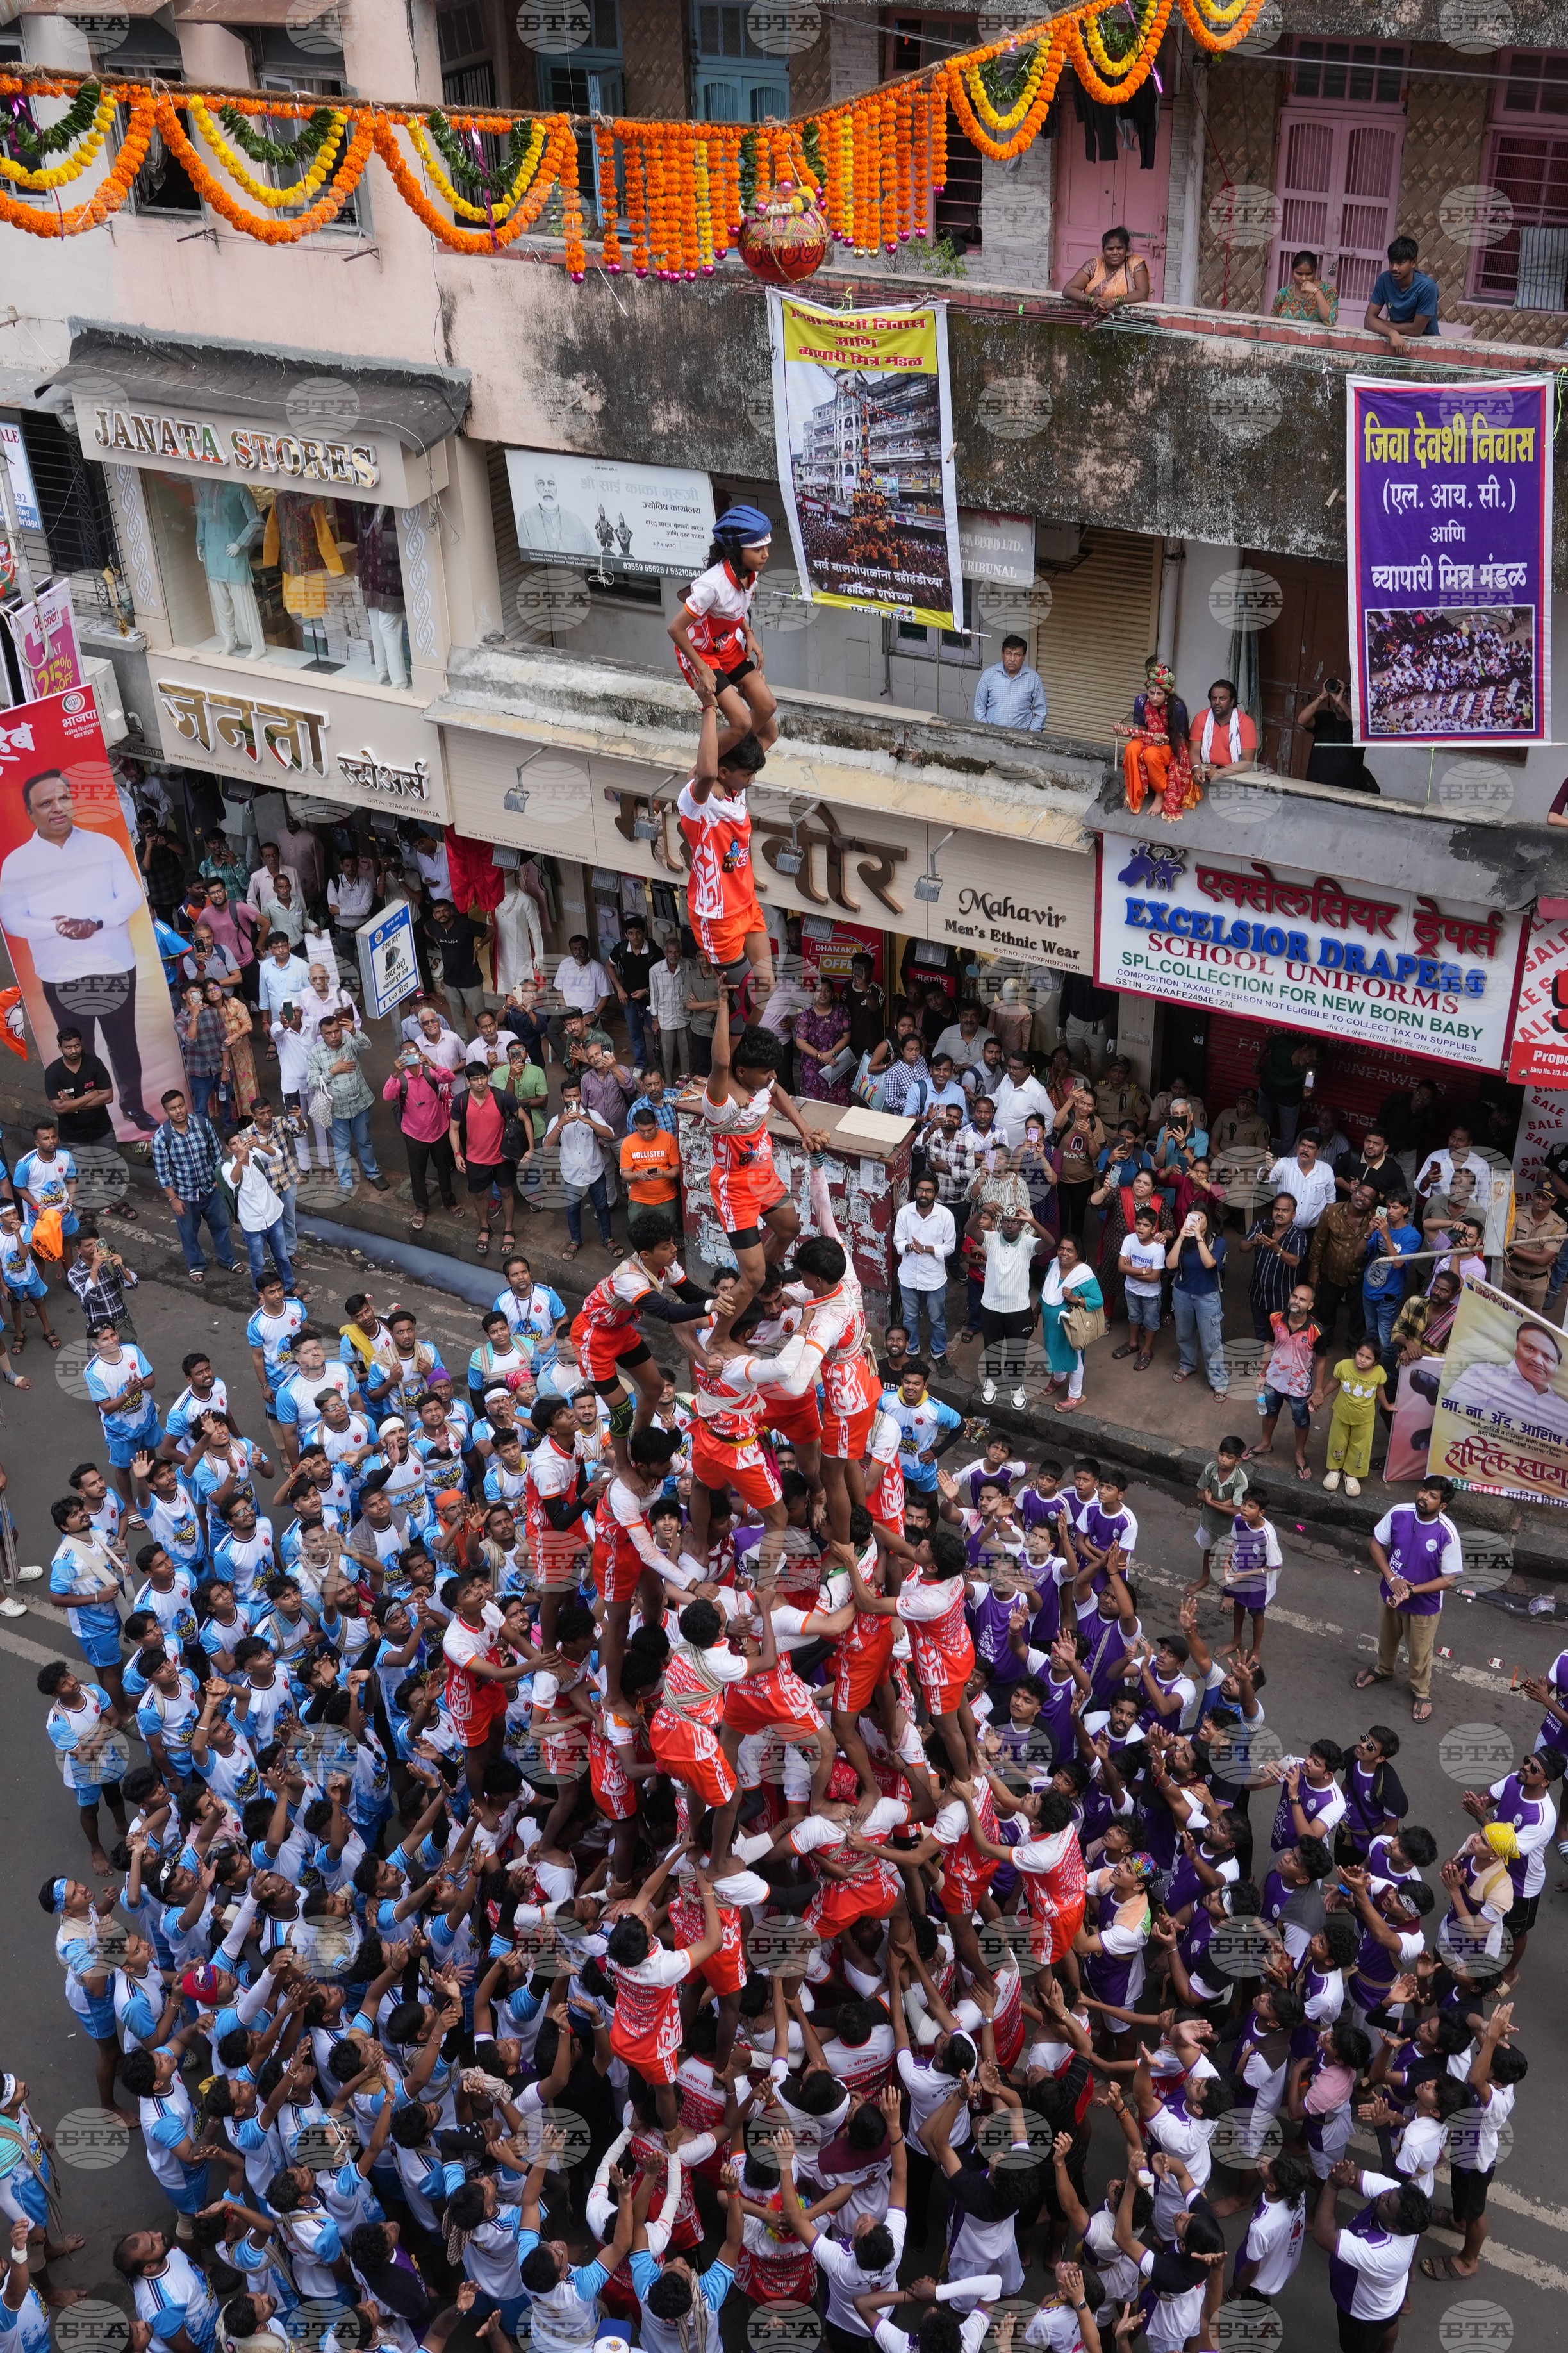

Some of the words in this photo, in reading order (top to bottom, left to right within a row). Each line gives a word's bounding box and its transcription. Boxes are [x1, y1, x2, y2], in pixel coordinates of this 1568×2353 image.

[873, 317, 926, 330] निवास
[834, 336, 879, 348] आणि
[798, 346, 848, 363] व्यापारी
[850, 353, 880, 366] मित्र
[884, 352, 924, 367] मंडळ
[94, 408, 229, 465] JANATA
[231, 428, 381, 488] STORES
[1364, 411, 1409, 464] जिवा
[1414, 411, 1467, 469] देवशी
[1472, 412, 1535, 464] निवास
[581, 476, 595, 490] श्री
[598, 479, 621, 494] साई
[625, 483, 657, 497] काका
[1430, 483, 1473, 510] आय.
[642, 501, 668, 511] ज्योतिष
[670, 505, 702, 515] कार्यालय
[19, 517, 38, 528] Bridge
[1430, 519, 1466, 544] आणि
[623, 562, 643, 572] 83559
[645, 565, 664, 574] 55628
[813, 558, 829, 570] सर्व
[832, 561, 891, 580] बालगोपाळांना
[893, 570, 943, 588] दहीहंडीच्या
[961, 559, 1017, 578] TRIBUNAL
[1371, 554, 1433, 592] व्यापारी
[1439, 554, 1474, 591] मित्र
[1479, 552, 1528, 592] मंडळ
[877, 590, 913, 603] शुभेच्छा
[59, 670, 74, 690] OFF
[62, 709, 97, 728] भाजपा
[158, 678, 331, 776] जनता
[336, 746, 430, 801] स्टोअर्स
[367, 797, 384, 806] GSTIN
[959, 888, 1067, 928] Mahavir
[1196, 862, 1401, 941] एक्सेलसियर
[1413, 895, 1503, 960] ड्रेपर्स
[815, 944, 859, 954] DHAMAKA
[990, 928, 1037, 951] Ethnic
[1041, 939, 1080, 960] Wear
[1124, 897, 1310, 963] EXCELSIOR
[1319, 936, 1487, 1000] DRAPERS
[822, 958, 852, 969] OFFE
[994, 947, 1007, 955] GST
[1008, 949, 1019, 958] NO.
[1021, 952, 1080, 971] 27ADXPN8973H1ZH
[1148, 933, 1275, 976] SCHOOL
[1285, 961, 1459, 1015] UNIFORMS
[1115, 977, 1144, 990] GSTIN:
[1146, 984, 1233, 1009] 27AAAFE2494E1ZM
[1121, 951, 1274, 995] SPL.COLLECTION
[1279, 985, 1316, 1005] FOR
[1322, 994, 1367, 1015] NEW
[1370, 1003, 1423, 1028] BORN
[1430, 1017, 1484, 1042] BABY
[1117, 969, 1179, 987] COMPOSITION
[1182, 981, 1222, 997] TAXABLE
[1225, 991, 1263, 1006] PERSON
[1265, 1000, 1284, 1010] NOT
[1287, 1004, 1328, 1020] ELIGIBLE
[1331, 1013, 1344, 1022] TO
[1346, 1017, 1390, 1033] COLLECT
[1392, 1027, 1410, 1038] TAX
[1413, 1032, 1428, 1042] ON
[1430, 1036, 1477, 1053] SUPPLIES
[1328, 1038, 1412, 1066] BEAUTIFUL
[1533, 1049, 1568, 1065] Prope
[1531, 1095, 1565, 1117] SALE
[1528, 1119, 1563, 1129] SALE
[632, 1150, 665, 1159] HOLLISTER
[1442, 1397, 1462, 1414] मा.
[1465, 1404, 1486, 1422] ना.
[1519, 1422, 1563, 1445] आशिष
[1525, 1436, 1538, 1446] आणि
[1527, 1443, 1546, 1454] उपनगर
[1546, 1449, 1562, 1459] जिल्हा
[1445, 1435, 1512, 1477] हार्दिक
[1512, 1456, 1568, 1490] स्वाग
